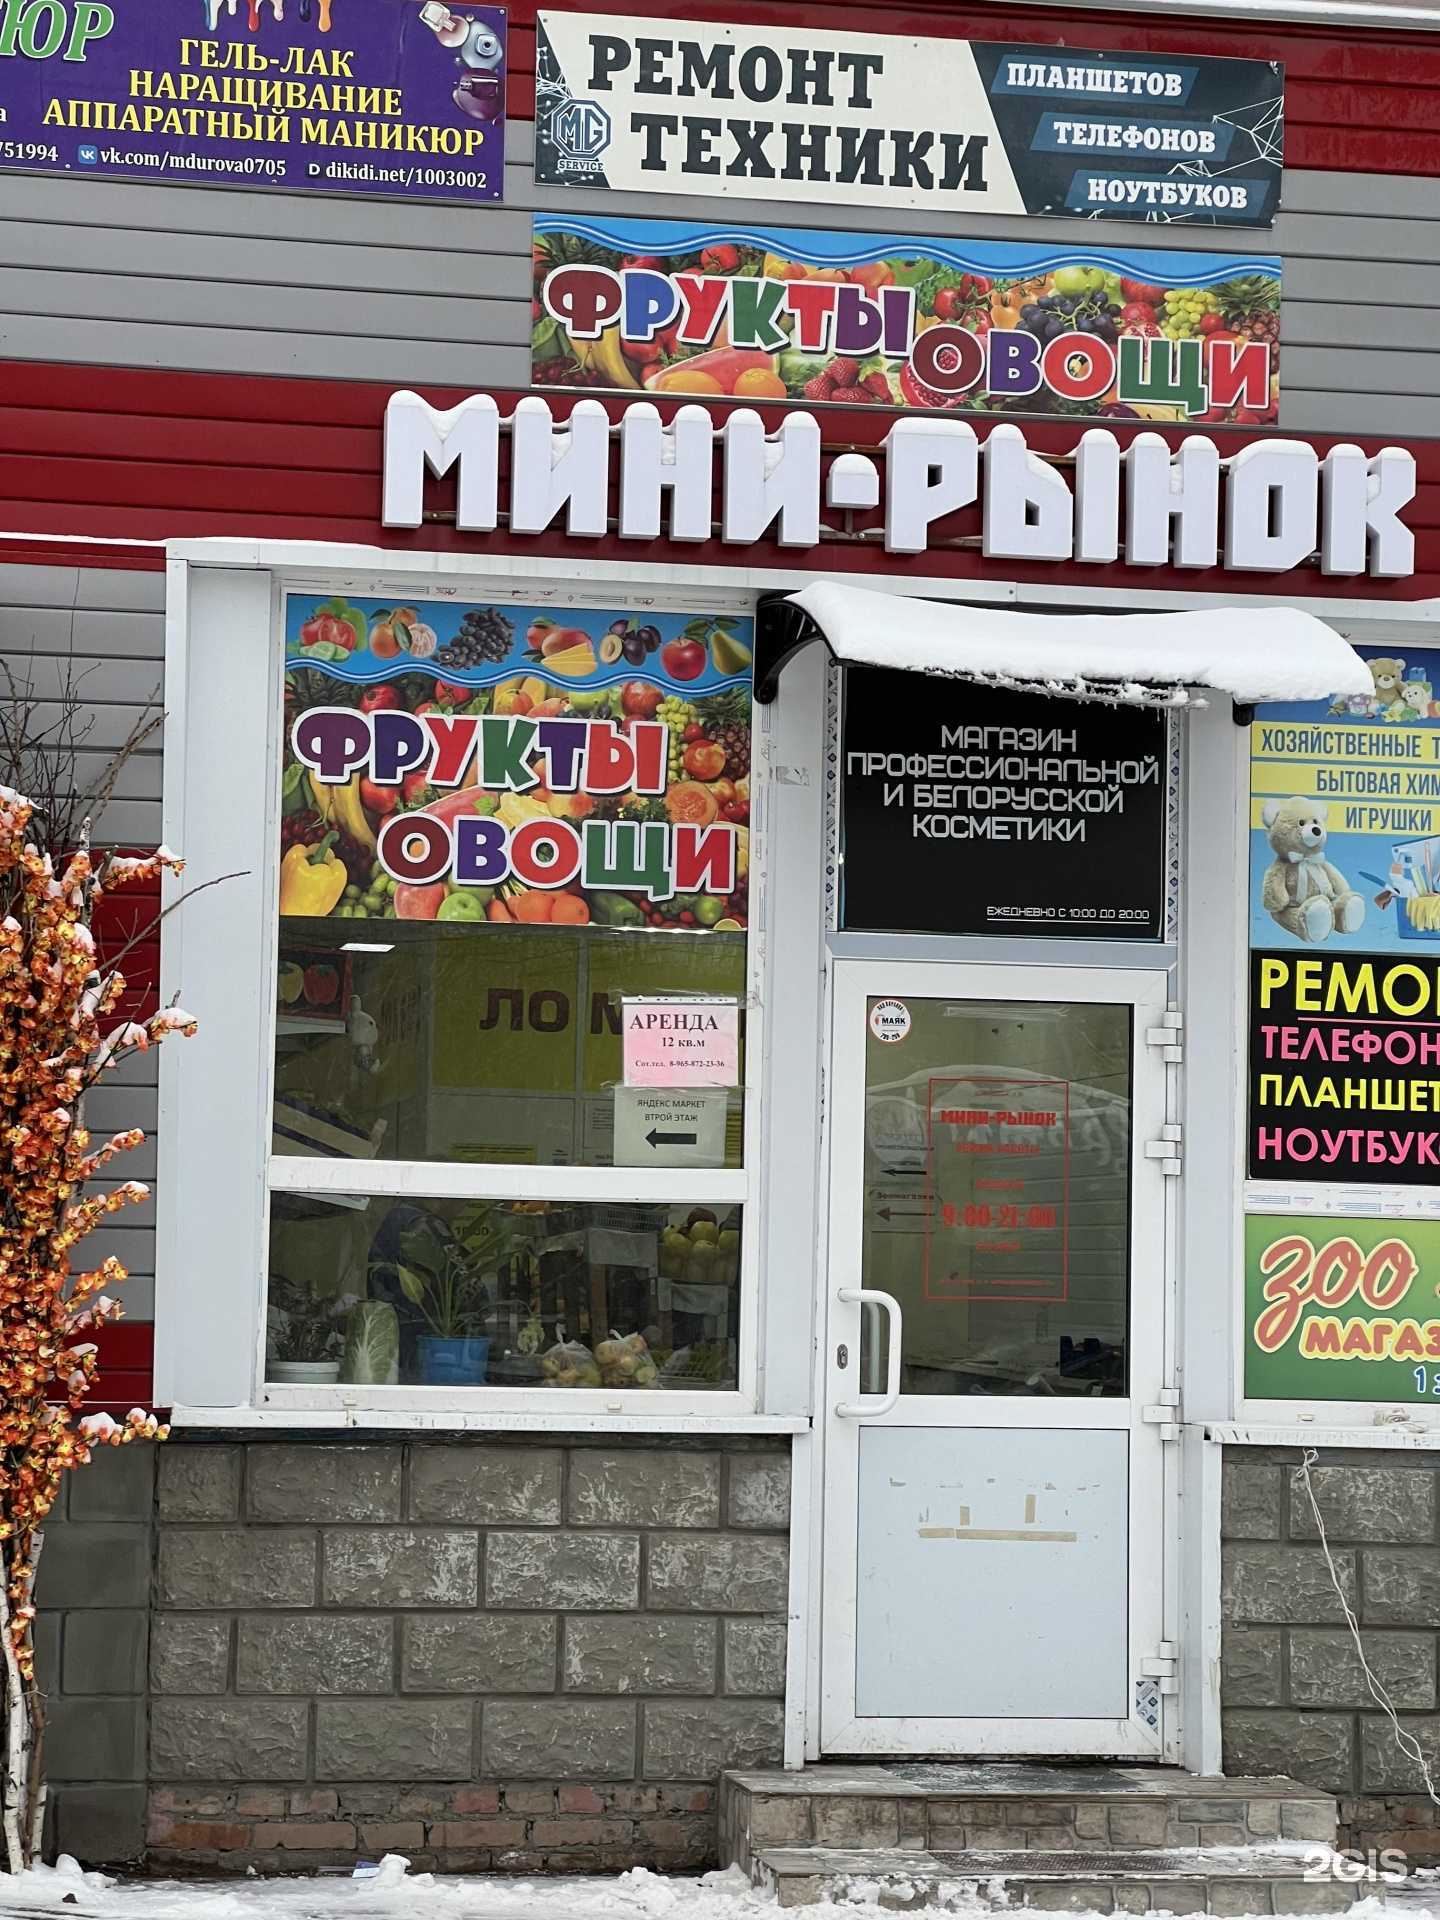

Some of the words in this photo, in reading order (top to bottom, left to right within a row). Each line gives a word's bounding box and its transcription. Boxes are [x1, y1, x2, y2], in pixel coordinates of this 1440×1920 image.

[180, 38, 355, 77] ГЕЛЬ-ЛАК
[587, 35, 884, 109] РЕМОНТ
[129, 70, 402, 116] НАРАЩИВАНИЕ
[1006, 63, 1183, 97] ПЛАНШЕТОВ
[42, 98, 290, 143] АППАРАТНЫЙ
[300, 116, 485, 157] МАНИКЮР
[561, 107, 604, 151] MG
[1053, 120, 1216, 153] ТЕЛЕФОНОВ
[100, 147, 287, 177] vk.com/mdurova0705
[558, 160, 605, 172] SERVICE
[631, 112, 989, 192] ТЕХНИКИ
[325, 161, 487, 189] dikidi.net/1003002
[1086, 178, 1248, 210] НОУТБУКОВ
[541, 263, 914, 357] ФРУКТЫ
[910, 328, 1271, 416] ОВОЩИ
[383, 392, 1417, 577] МИНИ-РЫНОК
[292, 706, 669, 795] ФРУКТЫ
[941, 725, 1077, 752] МАГАЗИН
[1261, 726, 1422, 758] ХОЗЯЙСТВЕННЫЕ
[847, 752, 1159, 785] ПРОФЕССИОНАЛЬНОЙ
[1316, 769, 1401, 795] БЫТОВАЯ
[884, 784, 904, 806] И
[913, 784, 1123, 814] БЕЛОРУССКОЙ
[913, 814, 1086, 842] КОСМЕТИКИ
[1345, 806, 1432, 832] ИГРУШКИ
[376, 811, 736, 902] ОВОЩИ
[986, 906, 1056, 918] ЕЖЕДНЕВНО
[1058, 907, 1067, 918] С
[1099, 908, 1116, 919] ДО
[630, 1013, 719, 1033] АРЕНДА
[881, 1016, 906, 1026] МАЯК
[662, 1037, 674, 1048] 12
[678, 1040, 705, 1048] кв.м
[1261, 1025, 1440, 1066] ТЕЛЕФОН
[637, 1099, 671, 1109] ЯНДЕКС
[672, 1100, 705, 1109] МАРКЕТ
[1259, 1073, 1440, 1113] ПЛАНШЕТ
[645, 1111, 673, 1122] ВТРОЙ
[674, 1114, 699, 1122] ЭТАЖ
[1299, 1315, 1440, 1362] МАГАЗ
